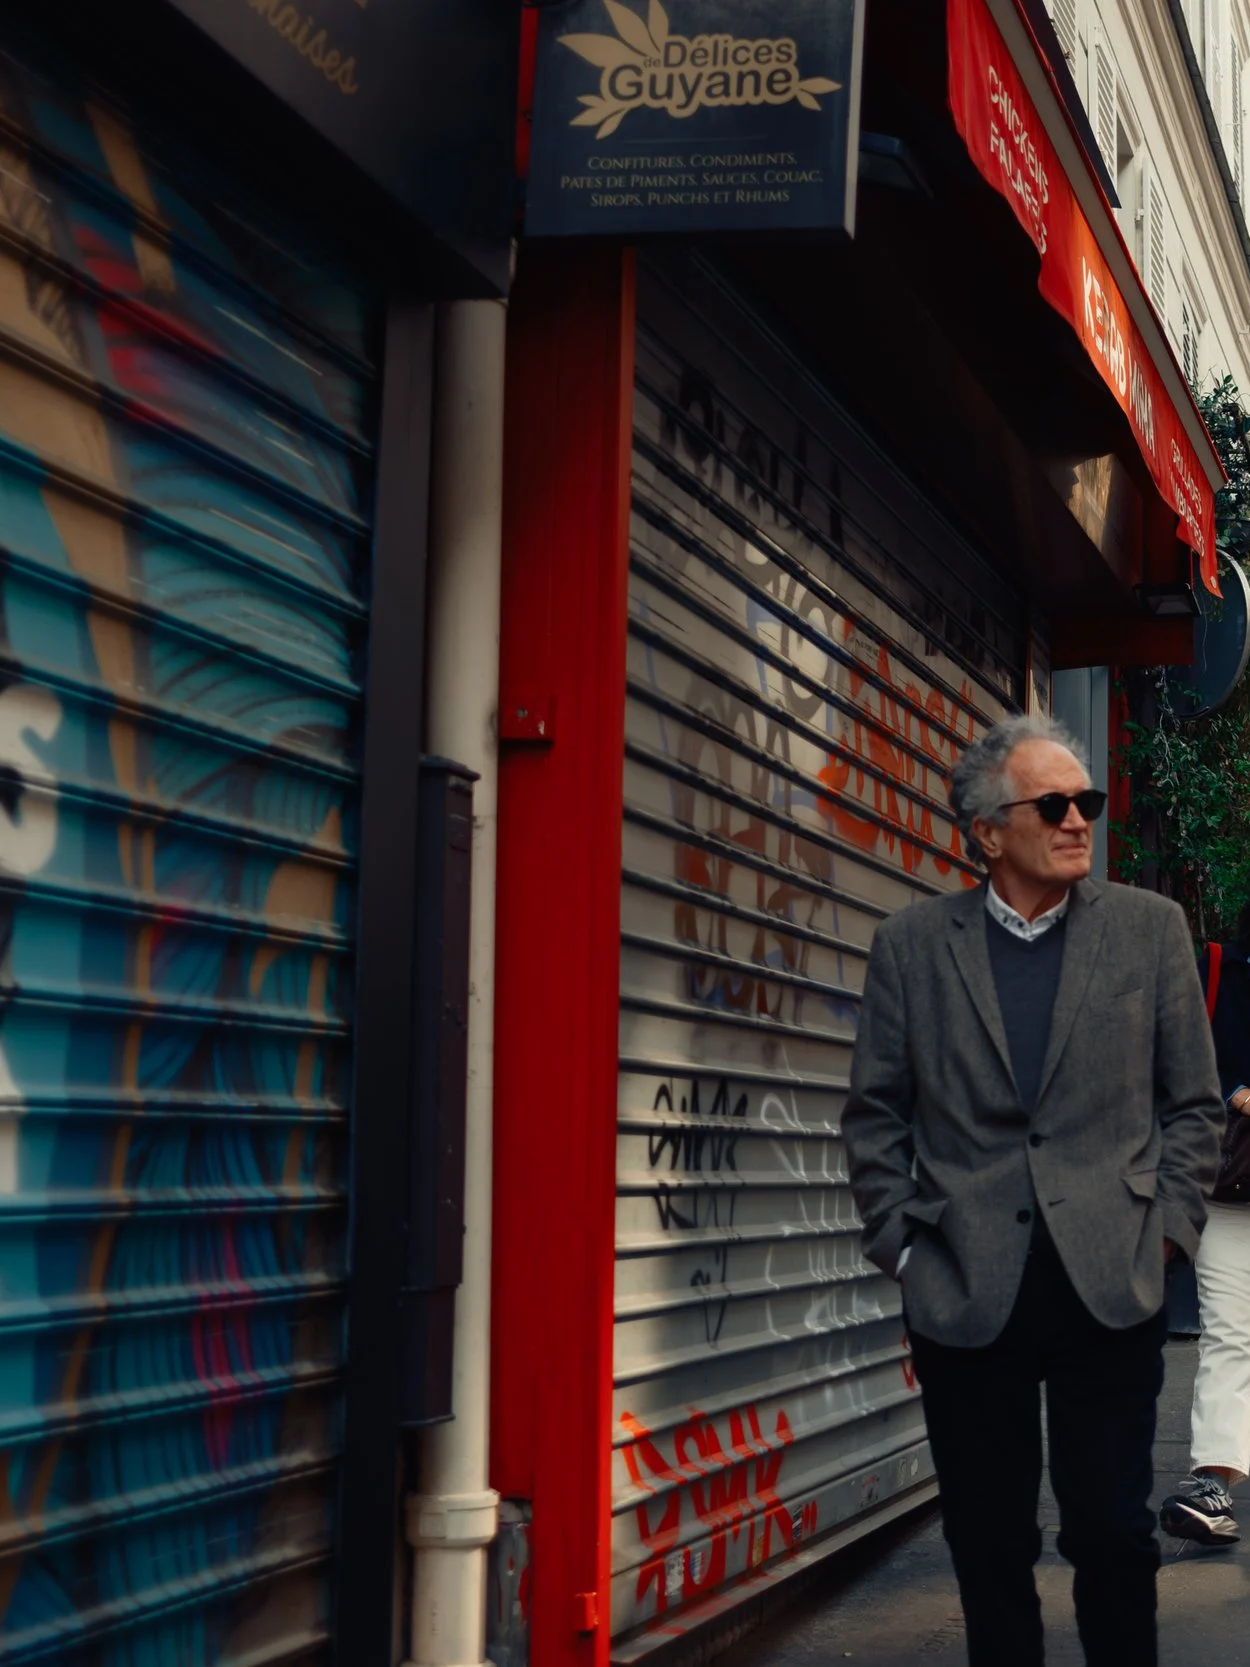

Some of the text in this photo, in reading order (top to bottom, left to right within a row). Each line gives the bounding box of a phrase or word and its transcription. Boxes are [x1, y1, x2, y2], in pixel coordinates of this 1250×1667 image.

[643, 57, 661, 68] de
[663, 40, 793, 68] Délices
[607, 64, 793, 110] Guyane
[735, 190, 790, 203] RHUMS
